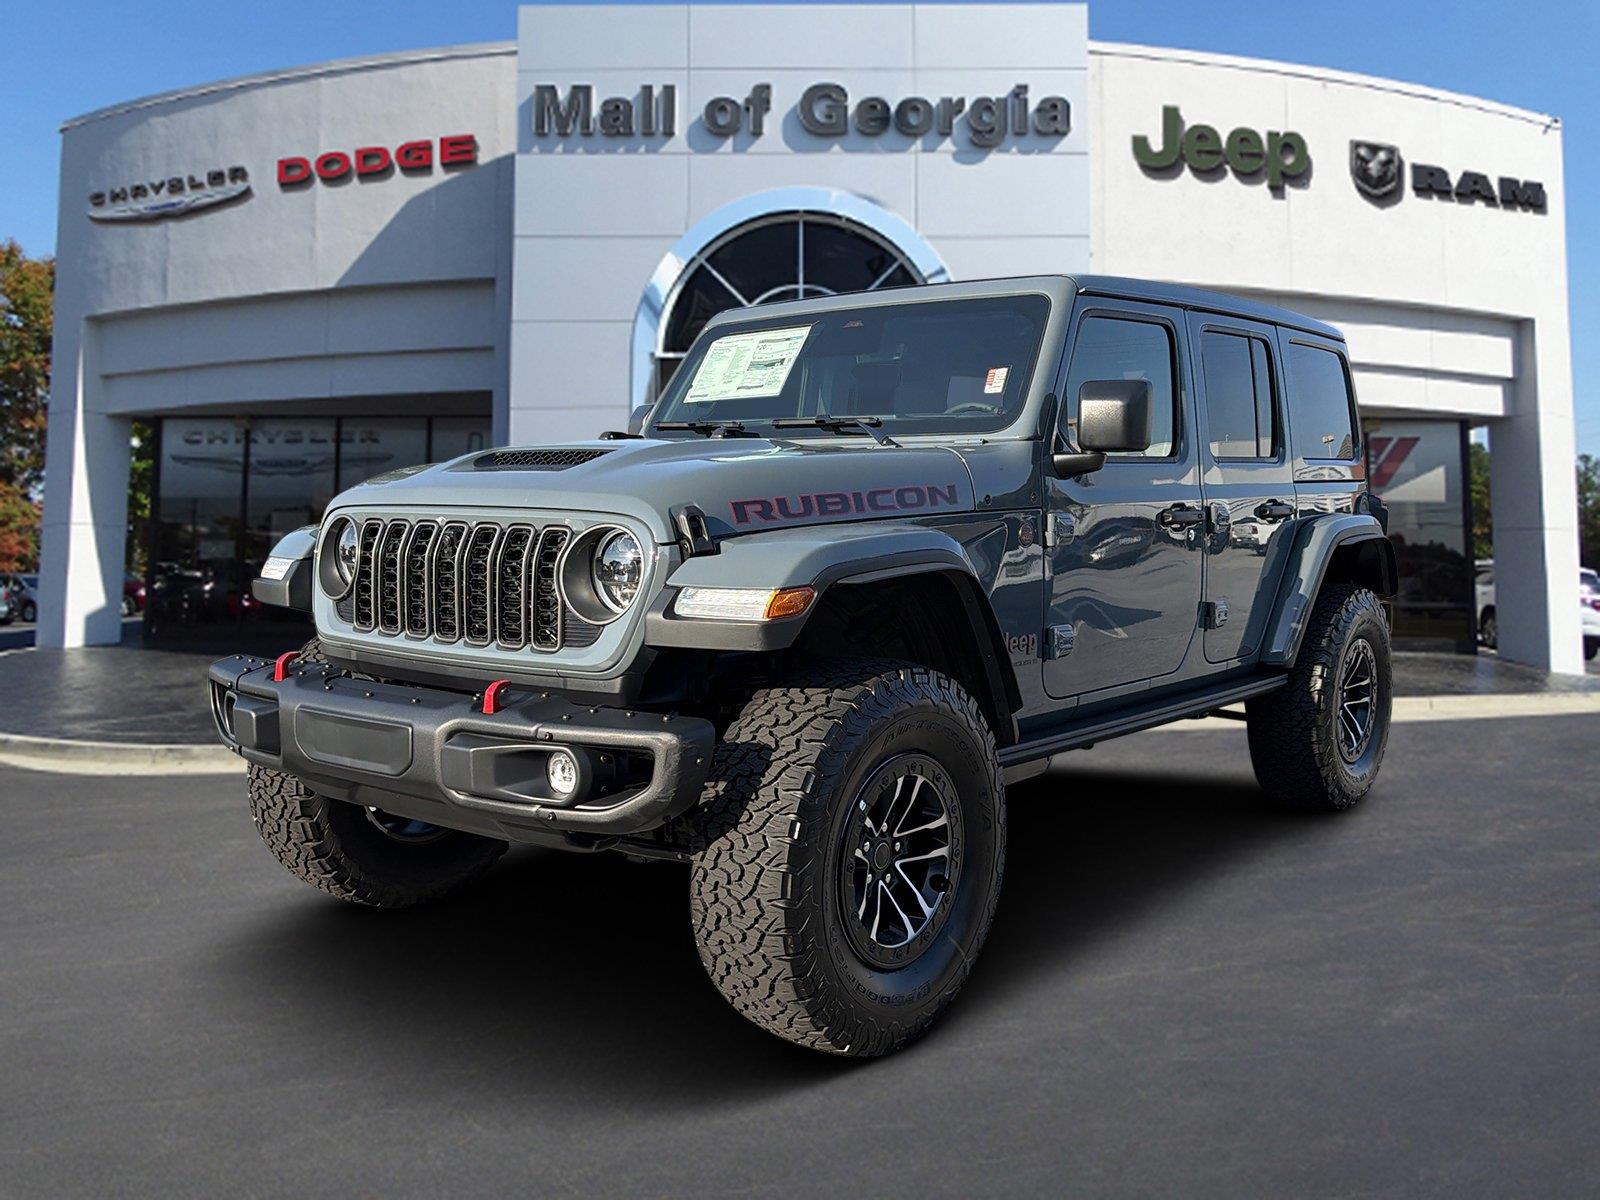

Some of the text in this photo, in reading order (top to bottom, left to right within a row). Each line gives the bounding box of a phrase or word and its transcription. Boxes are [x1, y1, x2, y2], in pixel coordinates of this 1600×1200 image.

[531, 81, 1072, 149] Mall of Georgia
[277, 134, 478, 190] DODGE
[1132, 105, 1310, 196] Jeep
[89, 166, 249, 206] CHRYSLER
[1411, 162, 1548, 214] RAM
[731, 484, 957, 522] RUBICON
